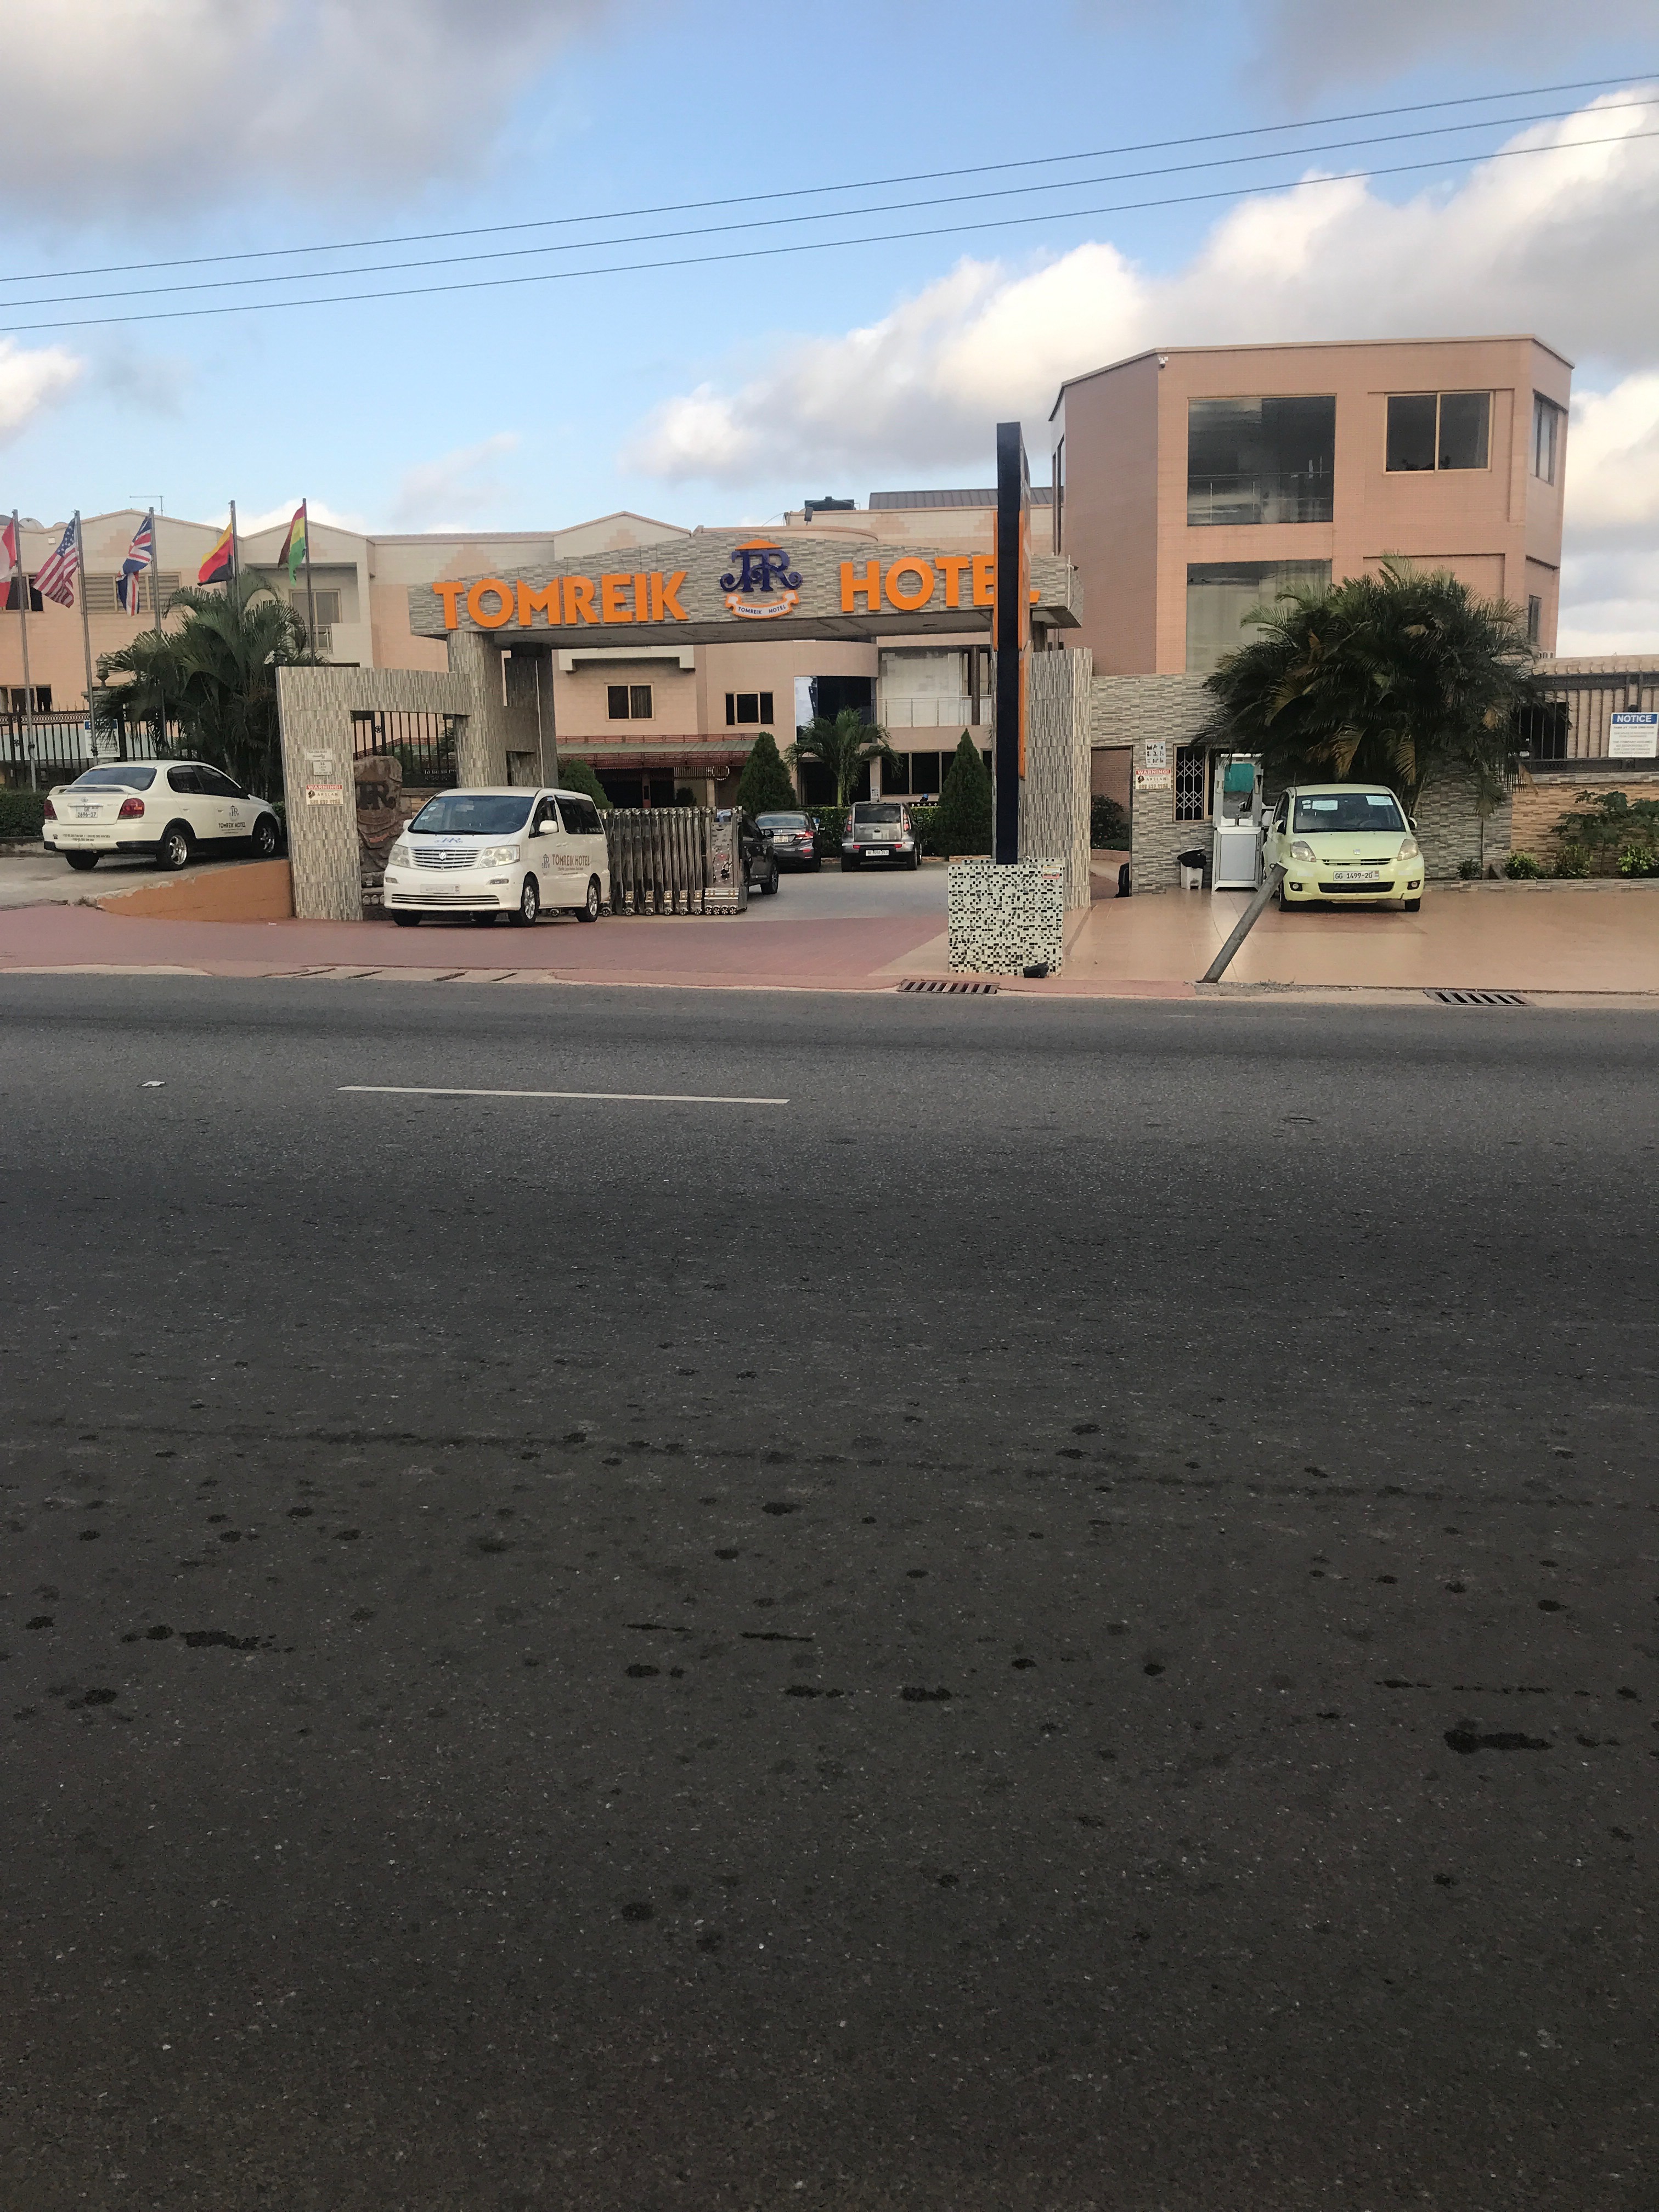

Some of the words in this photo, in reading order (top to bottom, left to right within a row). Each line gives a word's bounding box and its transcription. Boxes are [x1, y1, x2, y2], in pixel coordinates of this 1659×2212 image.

[432, 572, 689, 629] TOMREIK
[840, 555, 1041, 612] HOTE
[738, 606, 762, 614] TOMREIK
[769, 605, 786, 613] HOTEL
[552, 854, 574, 866] TOMREIK
[575, 855, 590, 866] HOTEL
